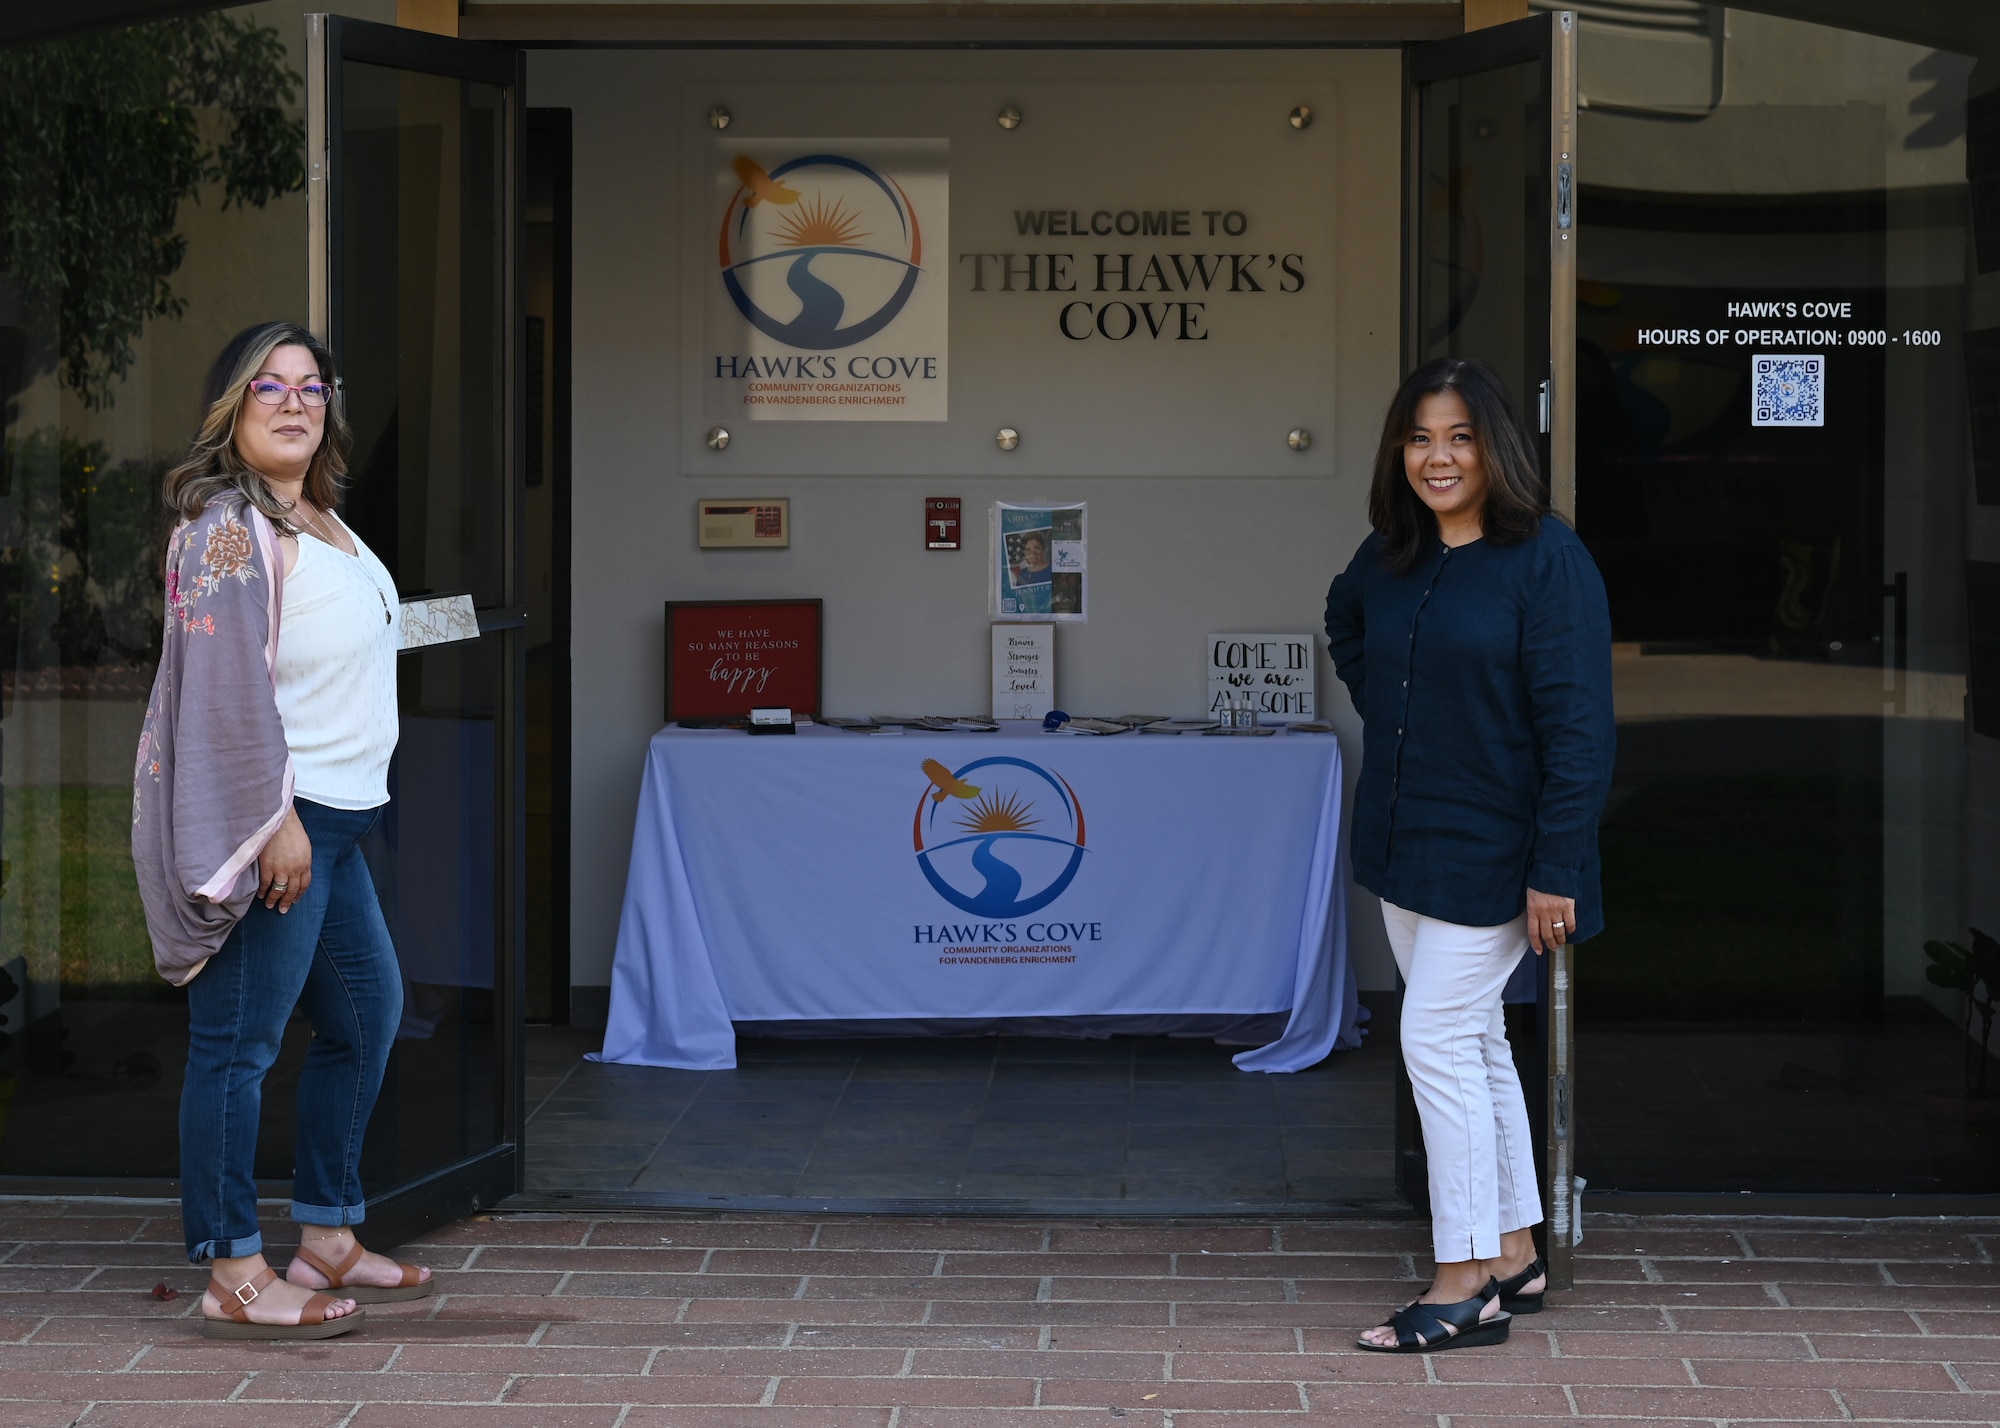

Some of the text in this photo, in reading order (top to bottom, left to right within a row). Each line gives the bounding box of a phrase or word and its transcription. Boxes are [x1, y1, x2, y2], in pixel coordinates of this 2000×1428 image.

[1013, 210, 1248, 236] WELCOME TO
[959, 253, 1306, 293] THE HAWK'S
[1727, 302, 1851, 318] HAWK'S COVE
[1059, 301, 1208, 341] COVE
[1637, 329, 1700, 345] HOURS
[1705, 329, 1730, 345] OF
[1734, 329, 1843, 345] OPERATION:
[1847, 330, 1886, 345] 0900
[1902, 330, 1941, 345] 1600
[714, 355, 937, 379] HAWK'S COVE
[748, 383, 901, 392] COMMUNITY ORGANIZATIONS
[743, 395, 906, 405] FOR VANDENBERG ENRICHMENT
[717, 629, 770, 639] WE HAVE
[688, 640, 799, 651] SO MANY REASONS
[1007, 637, 1035, 647] Braver
[725, 652, 760, 661] TO BE
[1007, 651, 1040, 662] Stronger
[1213, 640, 1308, 669] COME IN
[705, 657, 779, 694] happy
[1228, 672, 1293, 687] we are
[1009, 679, 1037, 692] Loved
[913, 922, 1102, 944] HAWK'S COVE
[943, 945, 1072, 954] COMMUNITY ORGANIZATIONS
[939, 955, 1077, 965] FOR VANDENBERG ENRICHMENT
